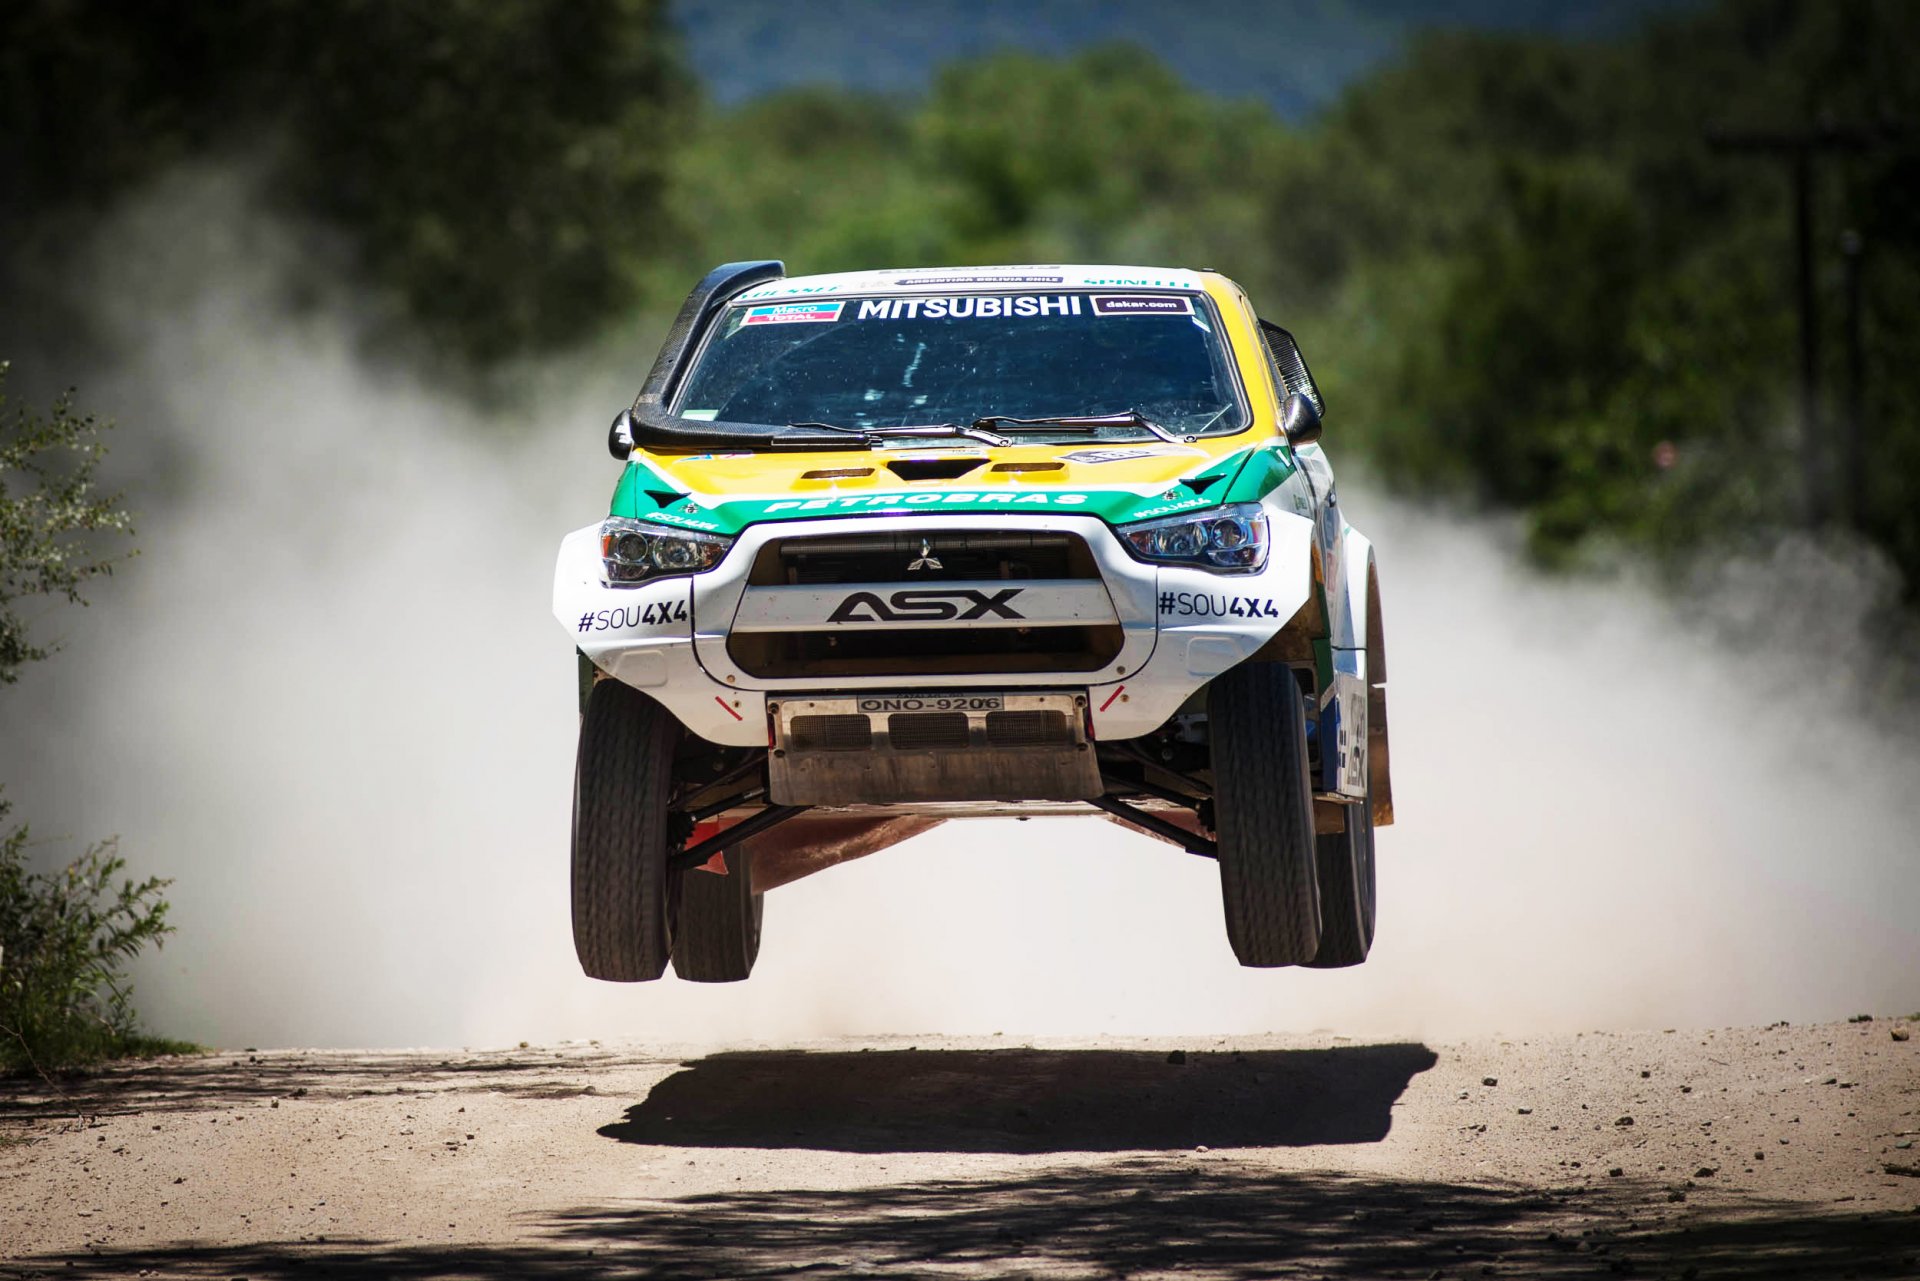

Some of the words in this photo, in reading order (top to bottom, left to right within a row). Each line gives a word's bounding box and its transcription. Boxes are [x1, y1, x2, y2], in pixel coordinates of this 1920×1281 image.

[773, 305, 818, 314] Macro
[857, 295, 1081, 319] MITSUBISHI
[763, 493, 1089, 513] PETROBRAS
[578, 600, 688, 632] #SOU4X4
[826, 588, 1026, 623] ASX
[1159, 591, 1279, 618] #SOU4X4
[861, 698, 1000, 711] ONO-9206
